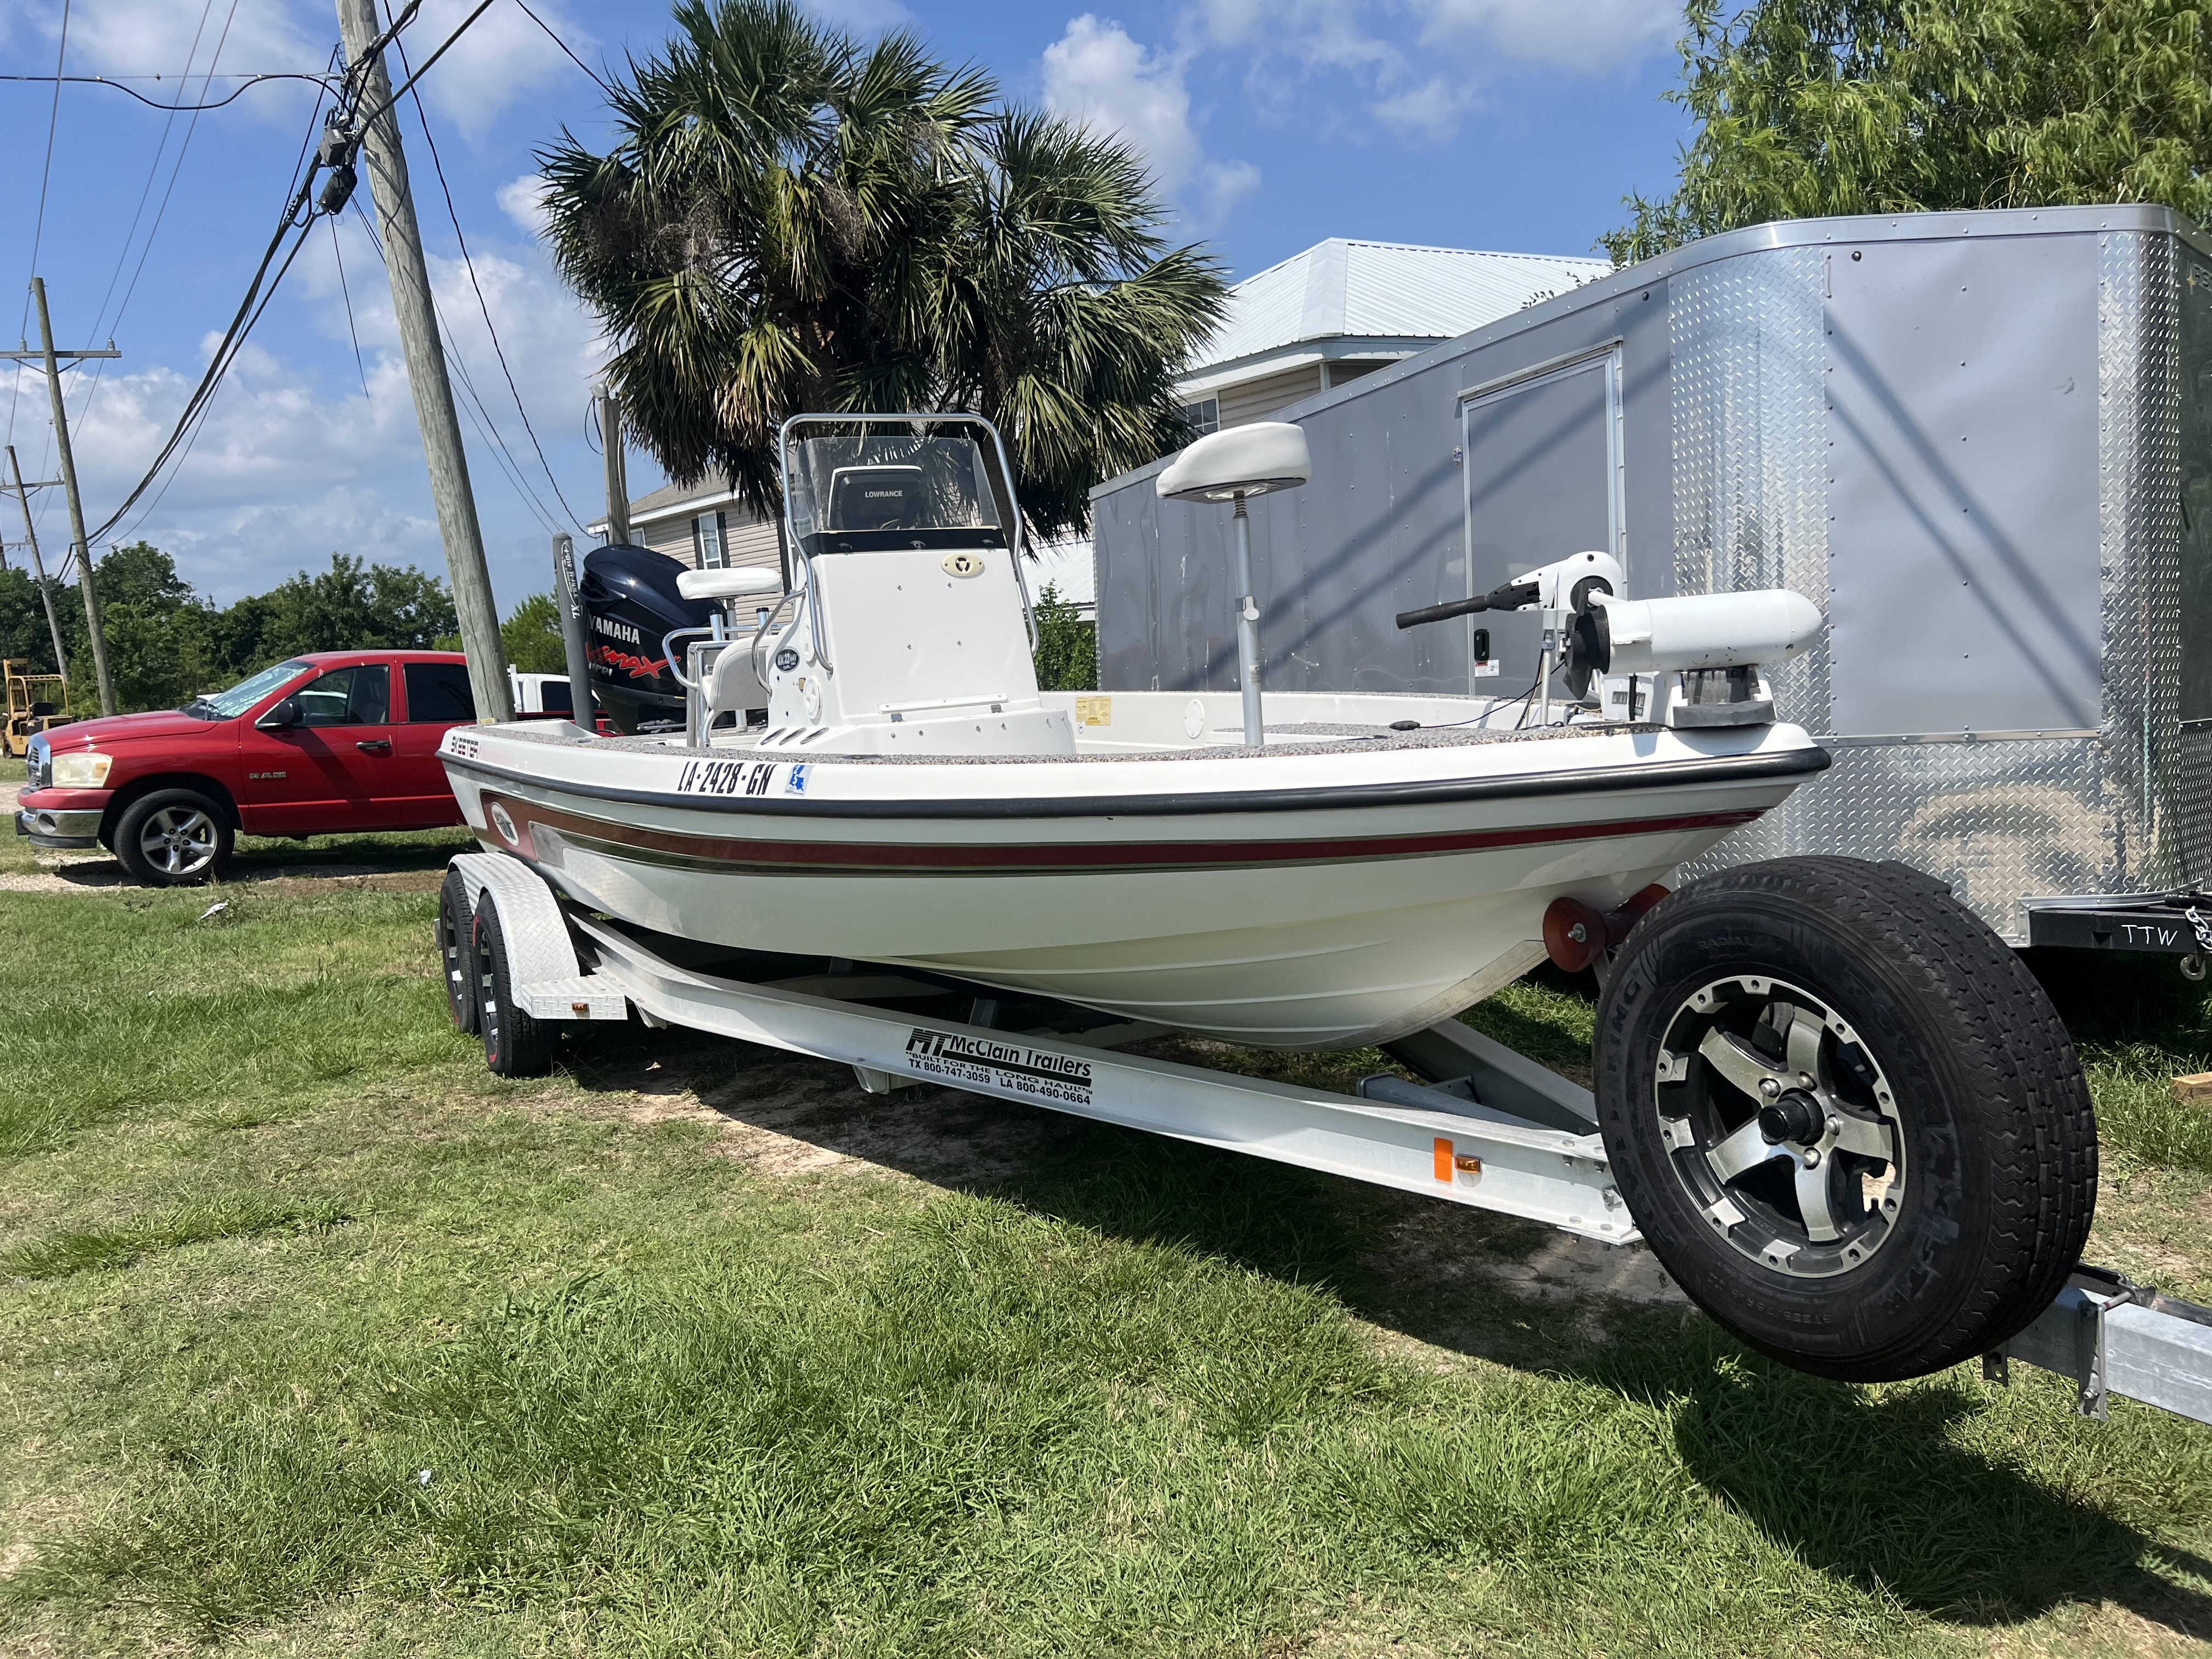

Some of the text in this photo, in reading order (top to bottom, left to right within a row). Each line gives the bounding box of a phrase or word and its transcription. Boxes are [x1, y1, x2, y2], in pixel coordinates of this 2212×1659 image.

[865, 490, 903, 498] LOWRANCE
[571, 604, 581, 619] XL
[589, 613, 640, 645] YAMAHA
[589, 662, 612, 676] HPDI
[451, 736, 479, 759] SKEETER
[677, 761, 778, 795] LA-2428-GN
[2121, 924, 2178, 946] TTW
[950, 1035, 1092, 1076] McClain Trailers
[909, 1058, 921, 1069] TX
[1000, 1077, 1013, 1088] LA
[944, 1059, 966, 1069] FOR
[969, 1064, 991, 1074] THE
[995, 1070, 1039, 1084] LONG
